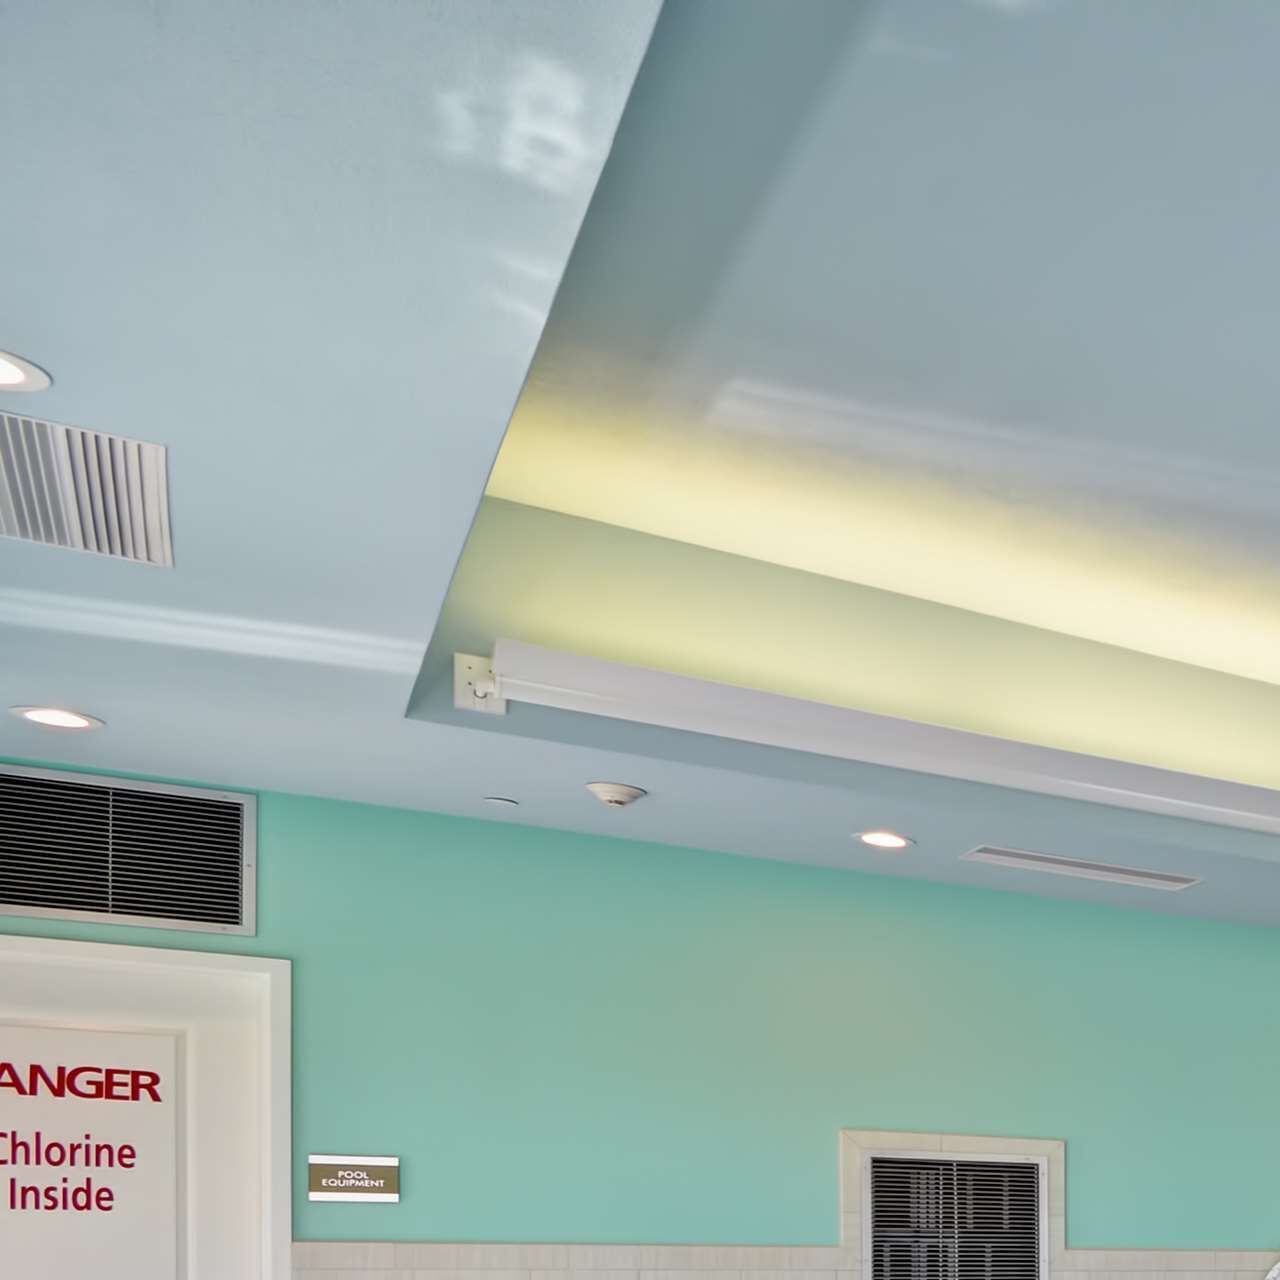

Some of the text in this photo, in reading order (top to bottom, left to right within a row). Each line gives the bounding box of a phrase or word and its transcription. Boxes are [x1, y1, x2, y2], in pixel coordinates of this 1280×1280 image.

[338, 1170, 369, 1179] POOL
[321, 1179, 385, 1188] EQUIPMENT
[9, 1176, 115, 1212] Inside
